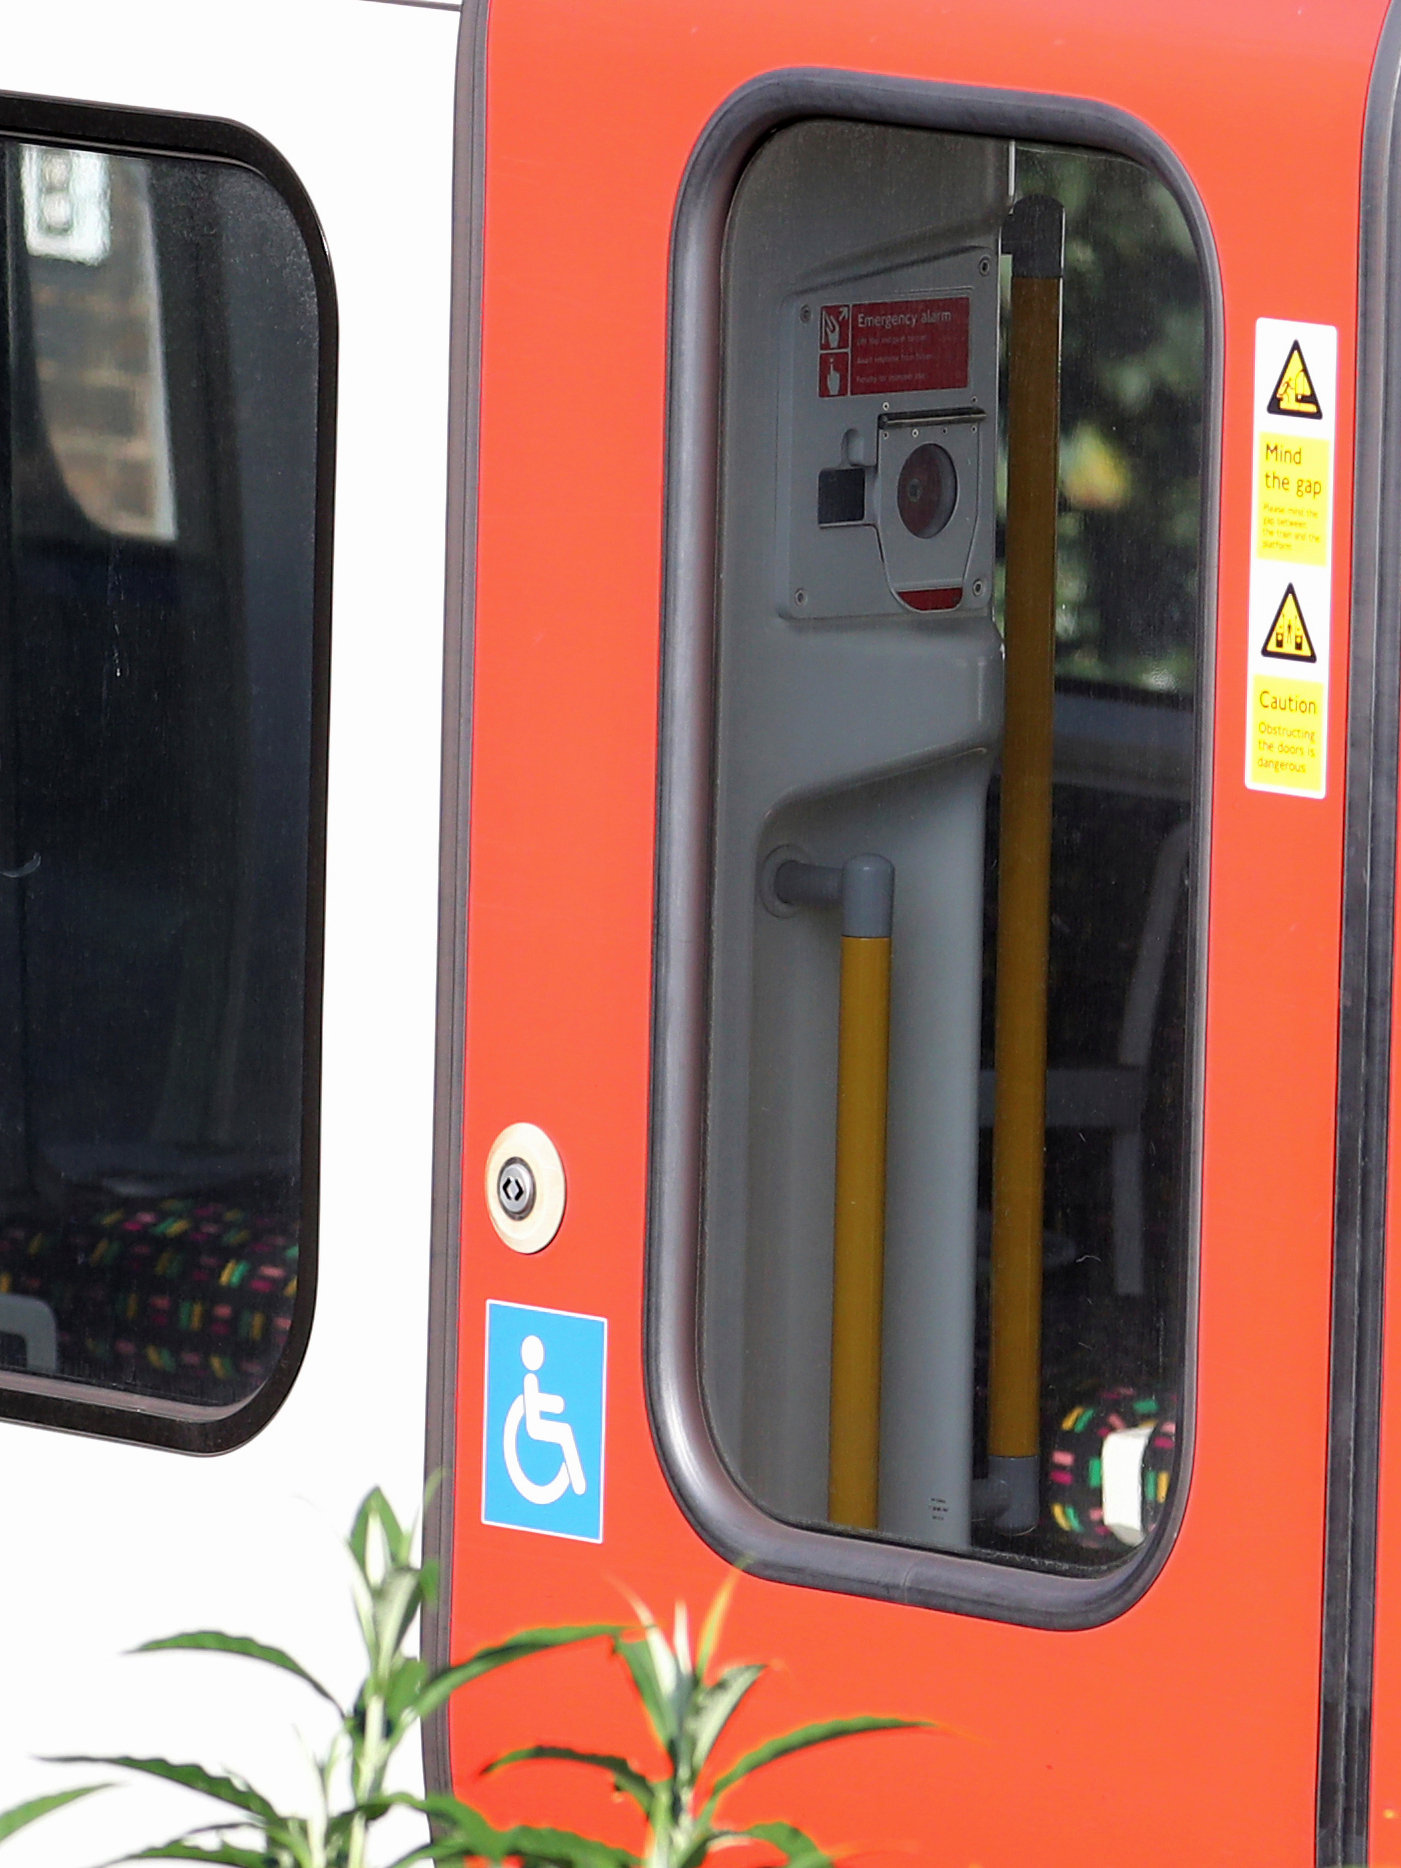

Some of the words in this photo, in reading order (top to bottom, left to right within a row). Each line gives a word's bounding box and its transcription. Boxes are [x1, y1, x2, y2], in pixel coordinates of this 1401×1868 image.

[857, 313, 918, 329] Emergency
[920, 309, 952, 323] alarm
[1265, 443, 1302, 465] Mind
[1265, 472, 1290, 491] the
[1296, 479, 1322, 499] gap
[1259, 690, 1316, 715] Caution
[1258, 722, 1316, 742] Obstructing
[1258, 740, 1274, 752] the
[1277, 744, 1304, 755] doors
[1307, 747, 1315, 757] is
[1257, 757, 1306, 773] dangerous
